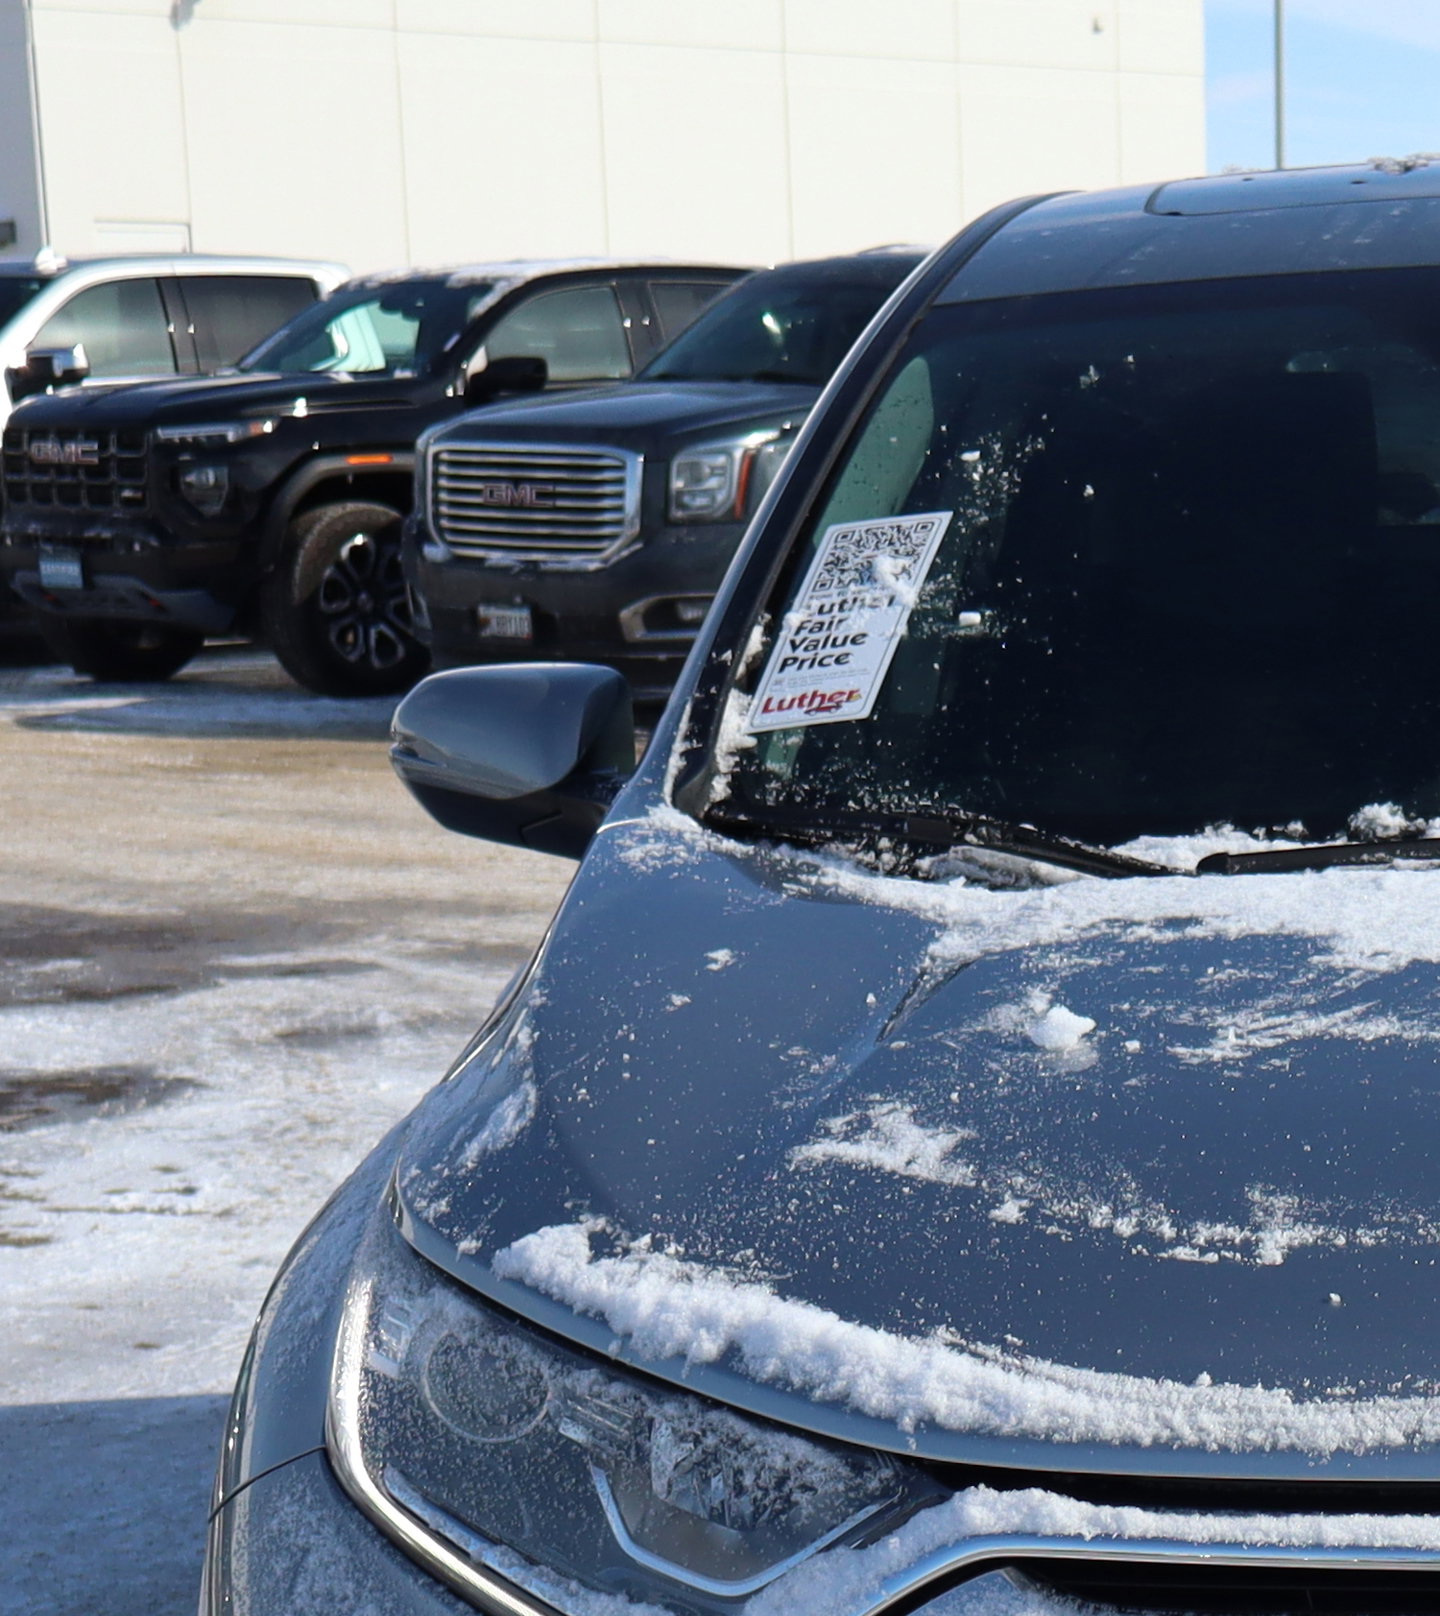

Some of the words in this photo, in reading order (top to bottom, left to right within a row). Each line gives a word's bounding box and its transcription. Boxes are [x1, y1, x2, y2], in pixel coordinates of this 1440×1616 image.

[30, 440, 99, 464] GMC
[482, 483, 556, 508] GMC
[794, 615, 850, 637] Fair
[789, 632, 869, 654] Value
[779, 652, 854, 674] Price
[761, 688, 860, 715] Luther
